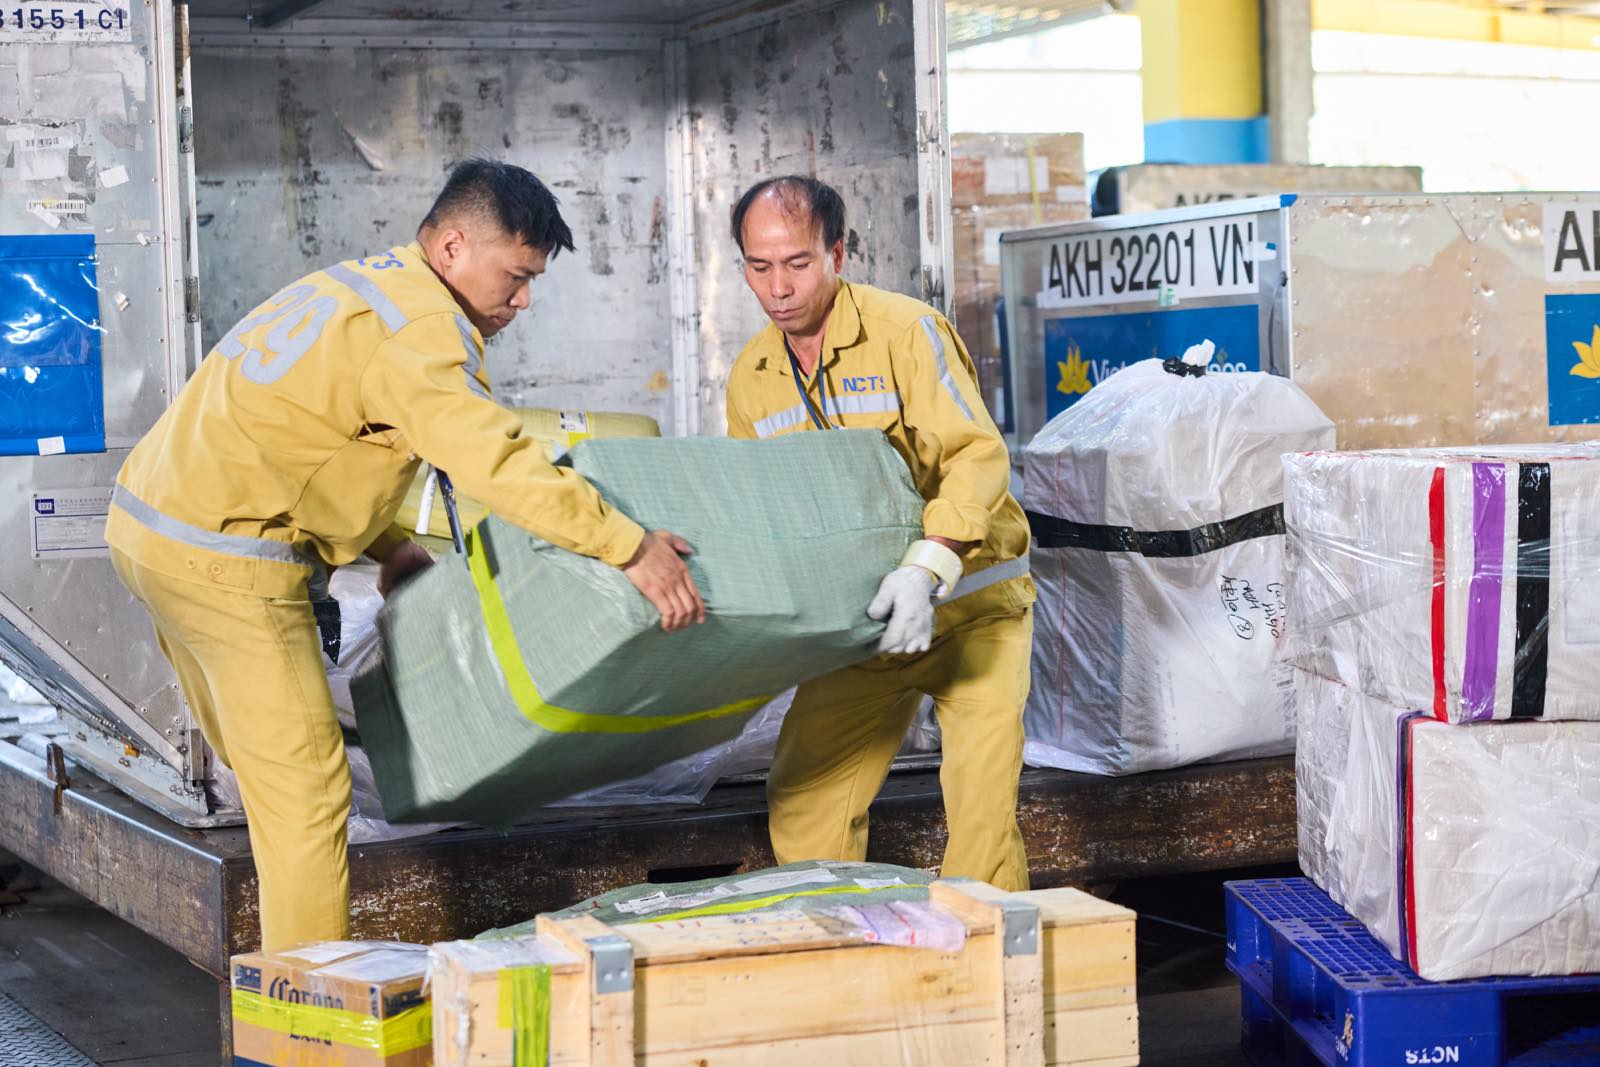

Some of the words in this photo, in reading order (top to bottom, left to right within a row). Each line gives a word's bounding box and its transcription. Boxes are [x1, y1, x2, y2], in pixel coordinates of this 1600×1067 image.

[1048, 239, 1103, 298] AKH
[1110, 228, 1195, 294] 32201
[1209, 221, 1254, 287] VN
[1553, 209, 1600, 273] A
[215, 283, 337, 385] 29
[1405, 1045, 1460, 1065] NCTS
